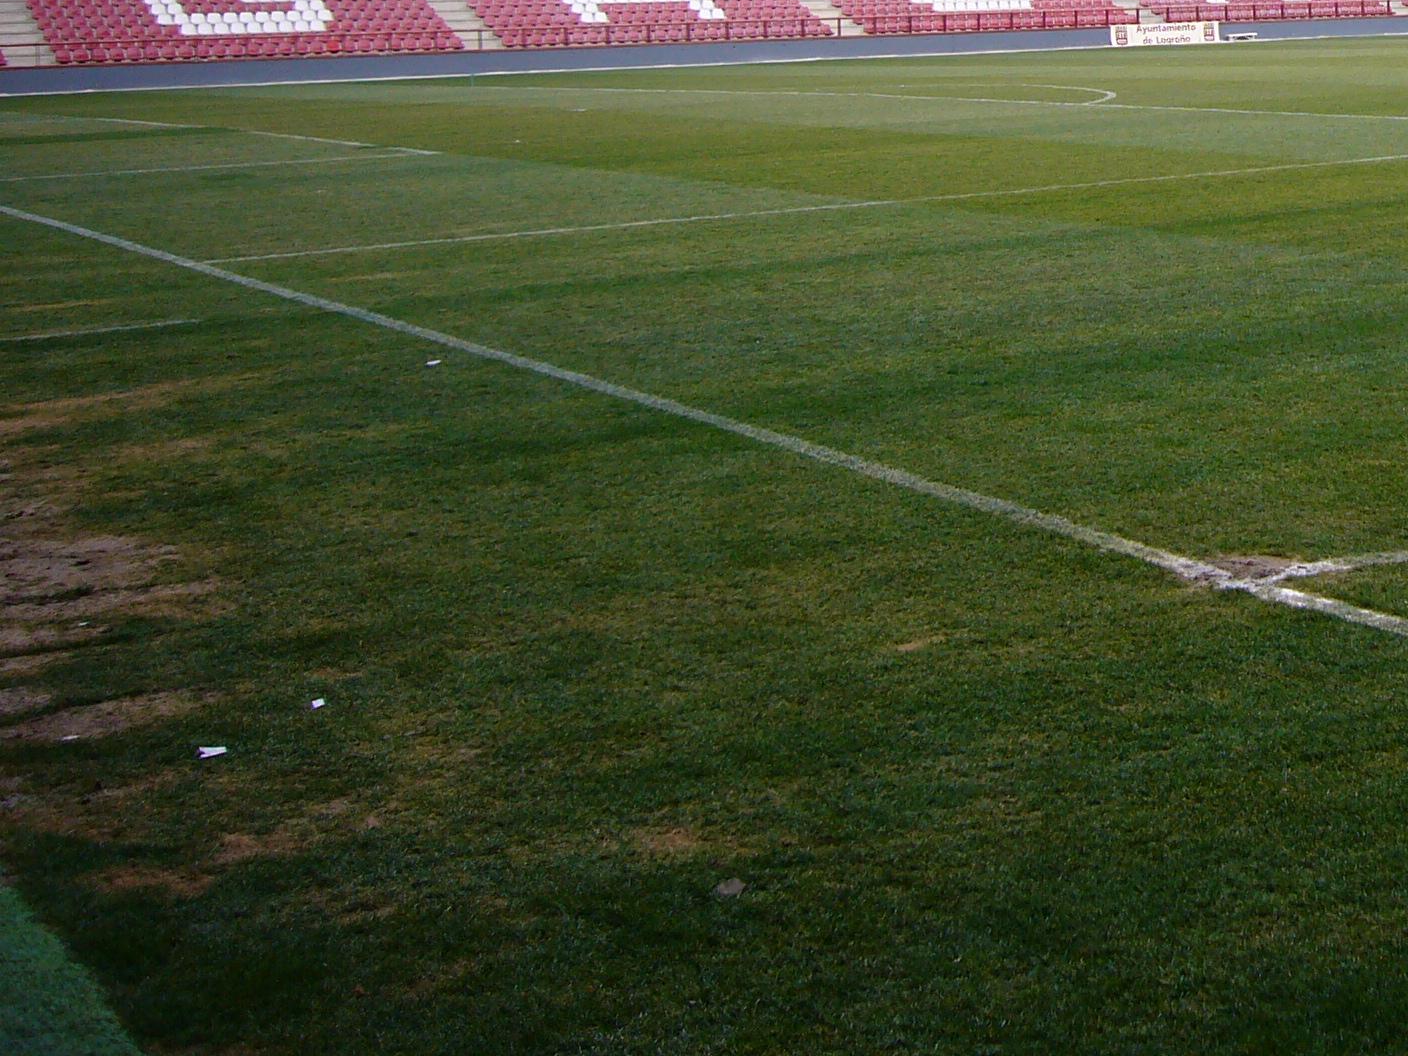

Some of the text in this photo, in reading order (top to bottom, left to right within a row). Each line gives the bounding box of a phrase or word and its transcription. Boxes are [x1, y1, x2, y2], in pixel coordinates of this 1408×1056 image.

[1136, 24, 1197, 34] Ayuntamiento
[1143, 35, 1191, 44] de Logroño
